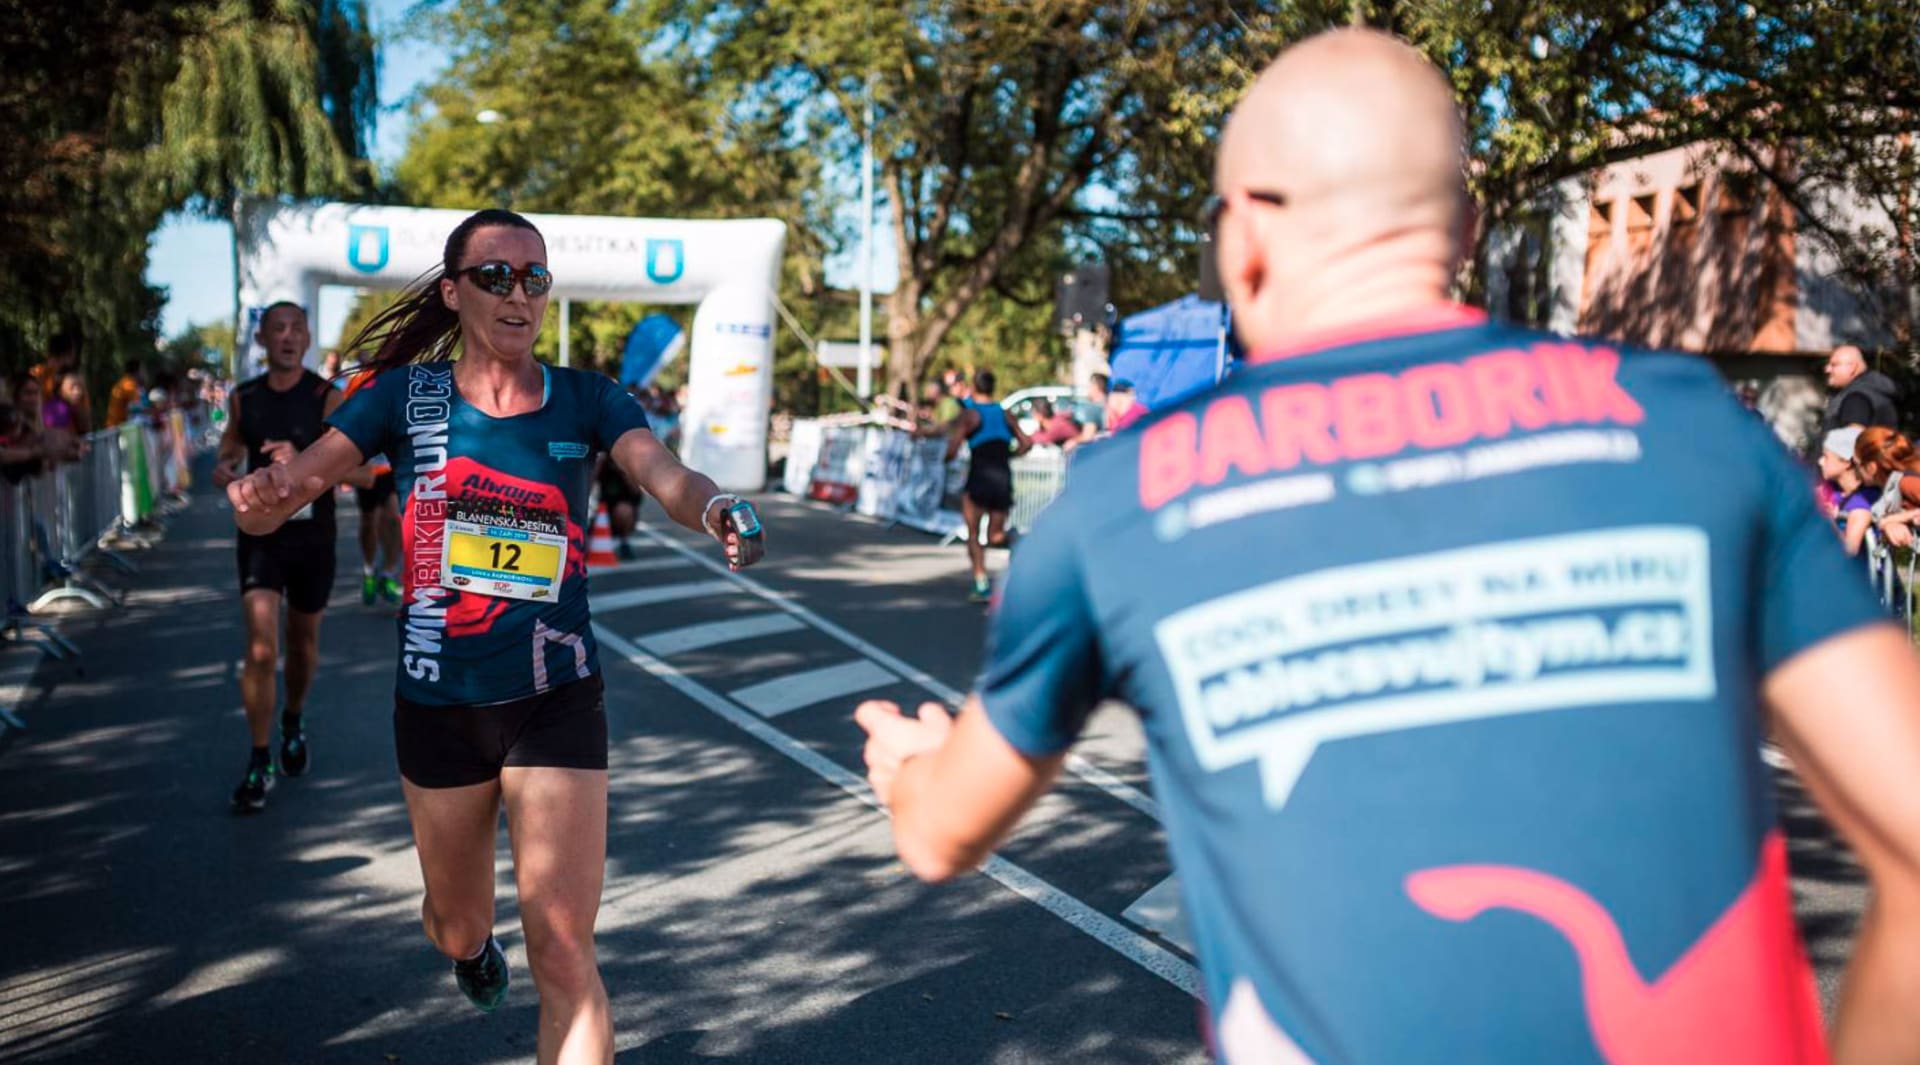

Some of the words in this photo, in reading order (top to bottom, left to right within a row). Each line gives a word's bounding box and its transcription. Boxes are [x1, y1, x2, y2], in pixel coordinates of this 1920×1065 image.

[1139, 342, 1645, 510] BARBORIK
[462, 473, 546, 504] Always
[490, 542, 521, 571] 12
